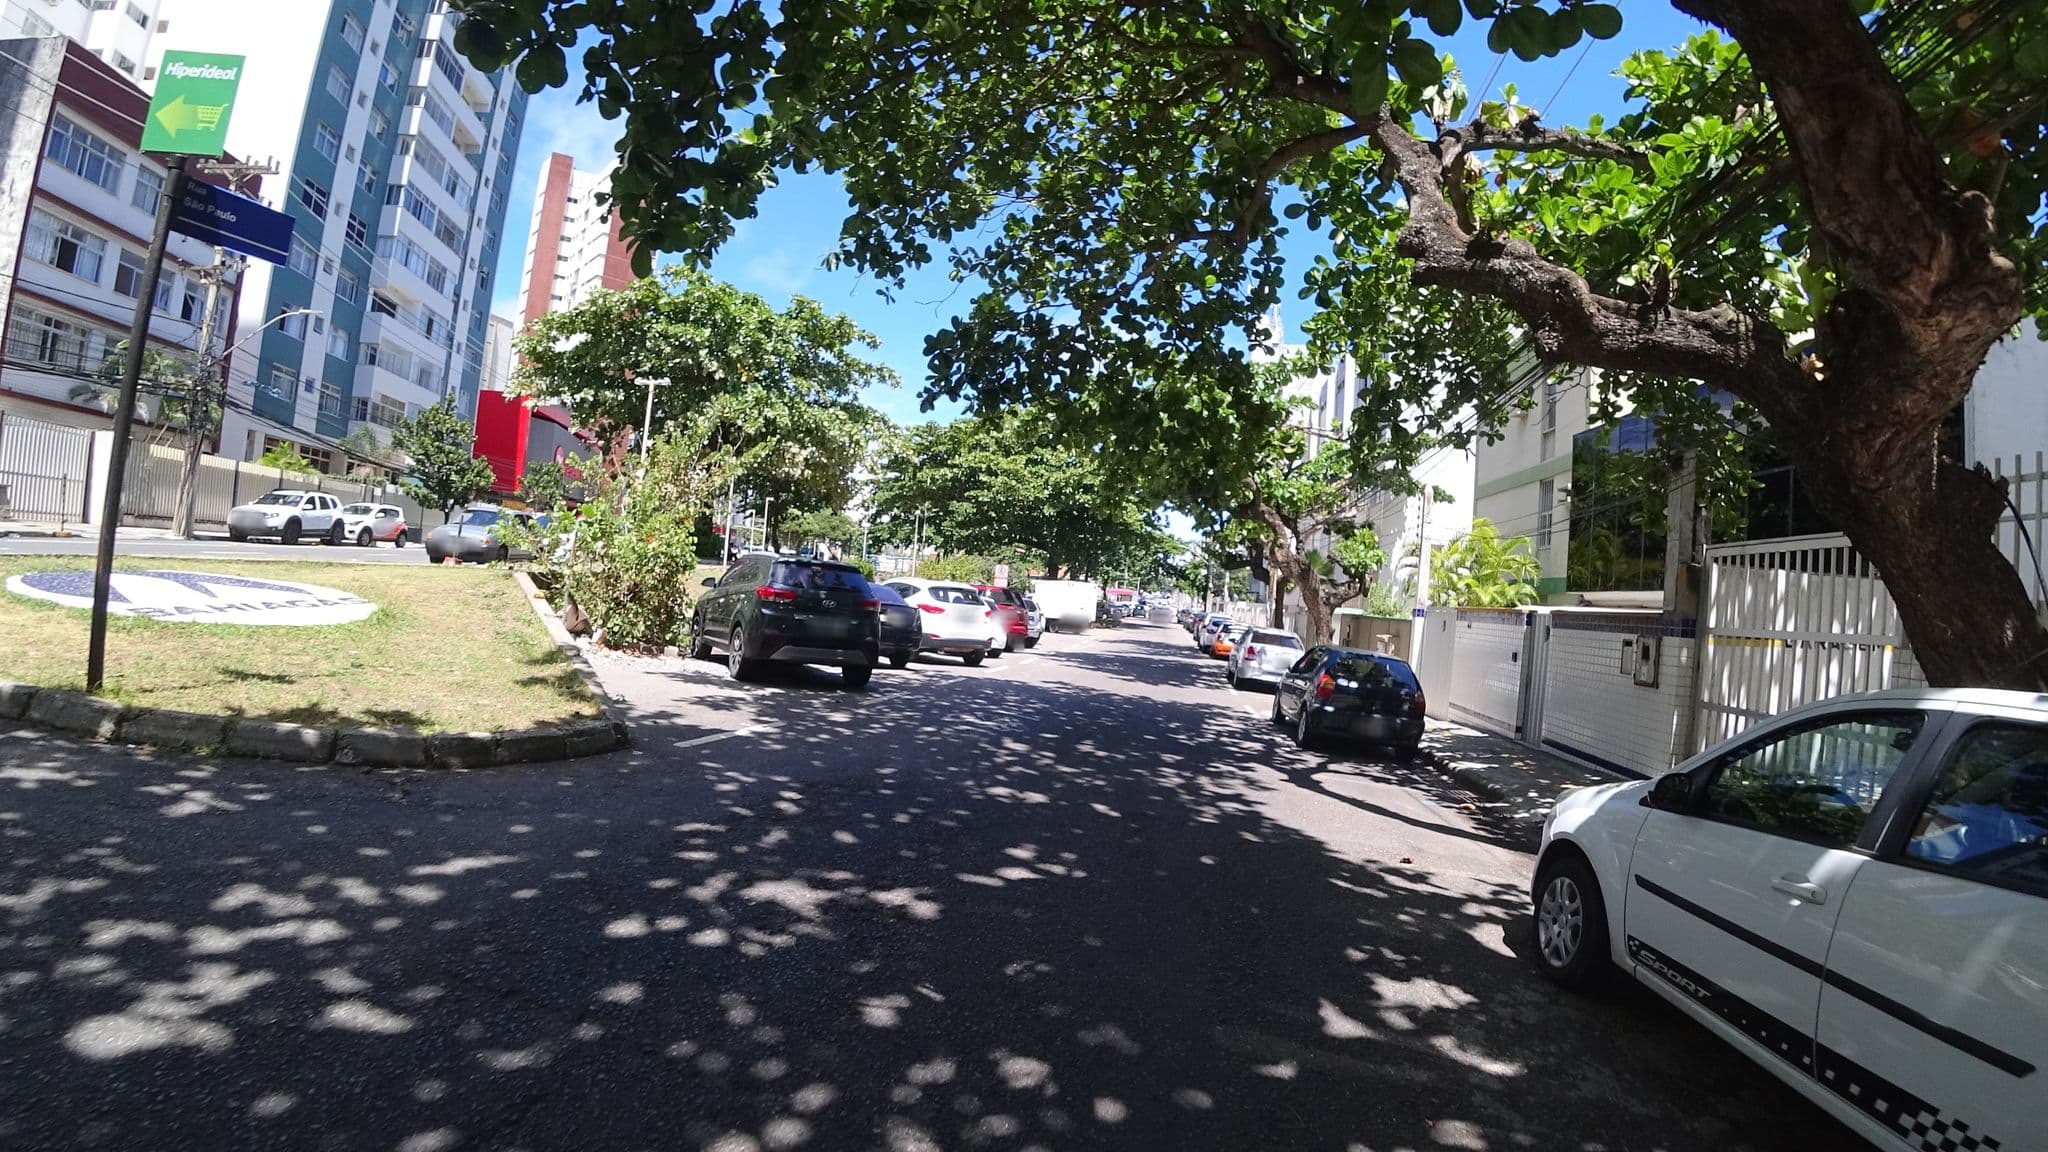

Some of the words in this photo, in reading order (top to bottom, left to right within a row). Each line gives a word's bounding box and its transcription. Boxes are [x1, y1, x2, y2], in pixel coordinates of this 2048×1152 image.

[165, 62, 238, 80] Hiperideal
[187, 181, 207, 196] Rua
[184, 196, 205, 211] São
[206, 204, 237, 222] Paulo
[1637, 950, 1711, 998] SPORT
